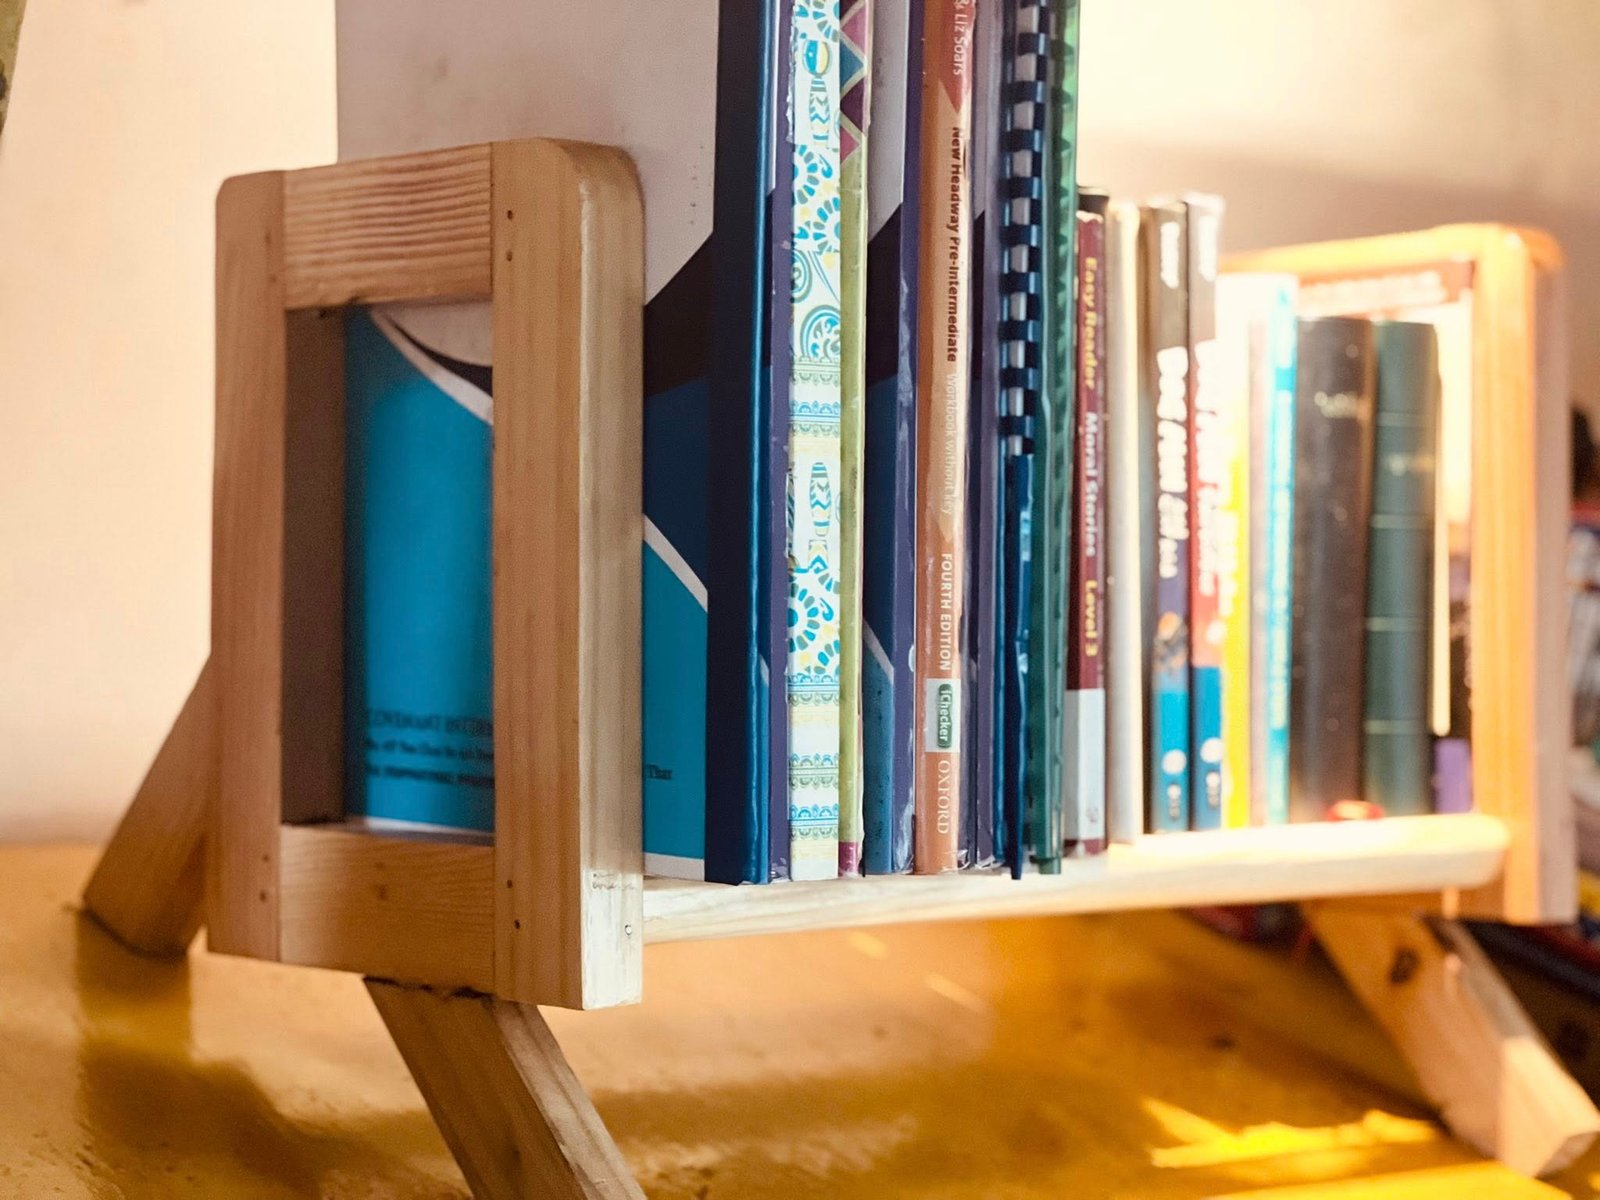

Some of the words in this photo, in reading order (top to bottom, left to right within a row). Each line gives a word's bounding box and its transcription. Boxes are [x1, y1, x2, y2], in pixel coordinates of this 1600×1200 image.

[954, 14, 969, 32] Liz
[953, 36, 967, 75] Soars
[952, 127, 961, 160] New
[947, 164, 961, 232] Headway
[947, 237, 960, 362] Pre-Intermediate
[1083, 257, 1097, 307] Easy
[1085, 311, 1098, 389] Reader
[945, 373, 957, 434] Workbook
[944, 440, 956, 490] without
[1085, 412, 1098, 477] Moral
[1085, 480, 1098, 557] Stories
[940, 553, 952, 609] FOURTH
[1085, 580, 1098, 638] Level
[939, 614, 951, 670] EDITION
[1085, 643, 1098, 656] 3
[939, 689, 952, 742] iChecker
[936, 760, 950, 834] OXFORD
